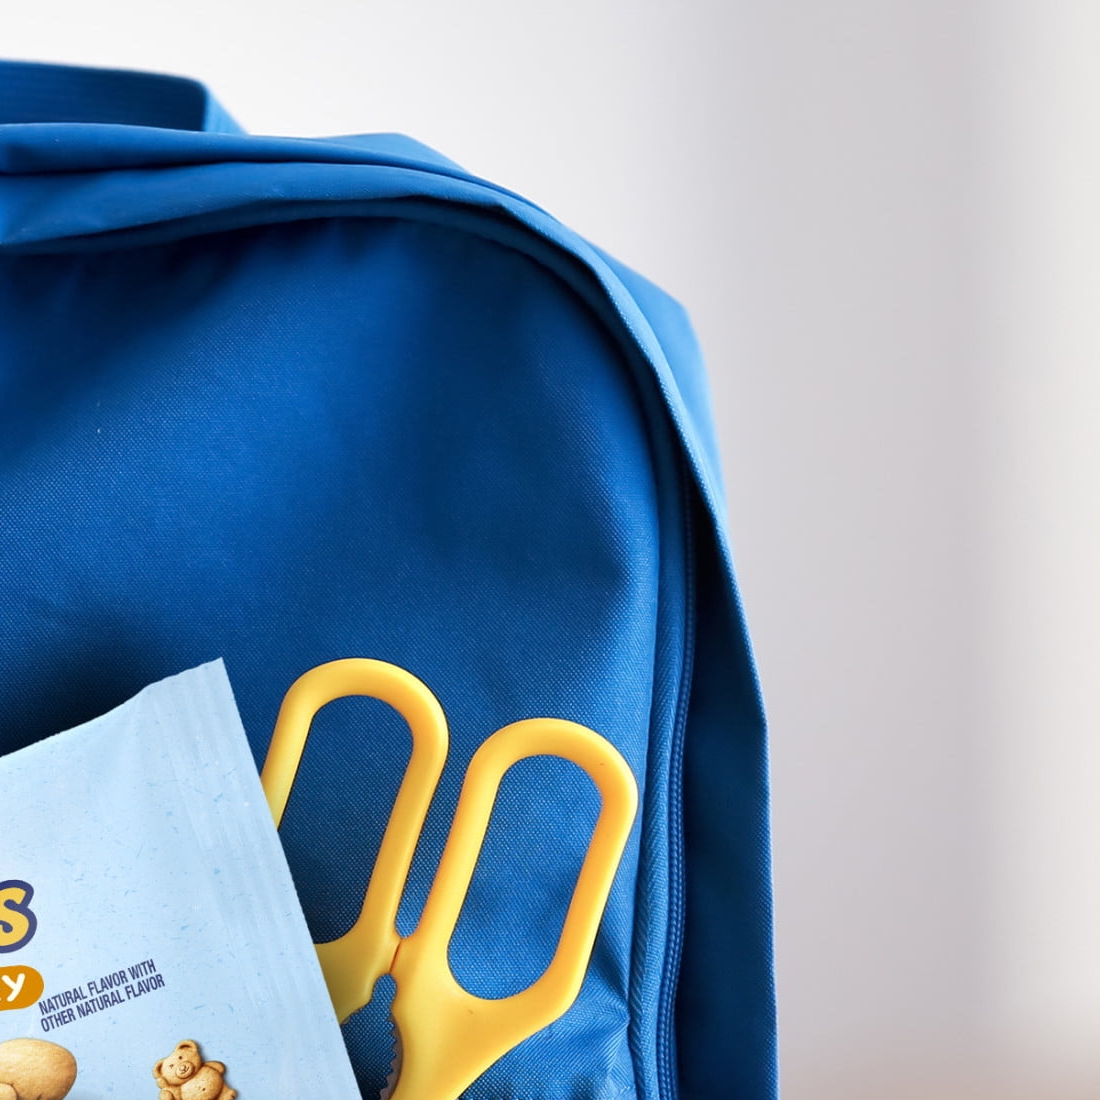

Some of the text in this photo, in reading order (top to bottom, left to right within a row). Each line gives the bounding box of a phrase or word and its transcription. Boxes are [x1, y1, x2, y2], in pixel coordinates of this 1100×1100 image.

[38, 958, 156, 1015] NATURAL FLAVOR WITH
[40, 973, 165, 1032] OTHER NATURAL FLAVOR
